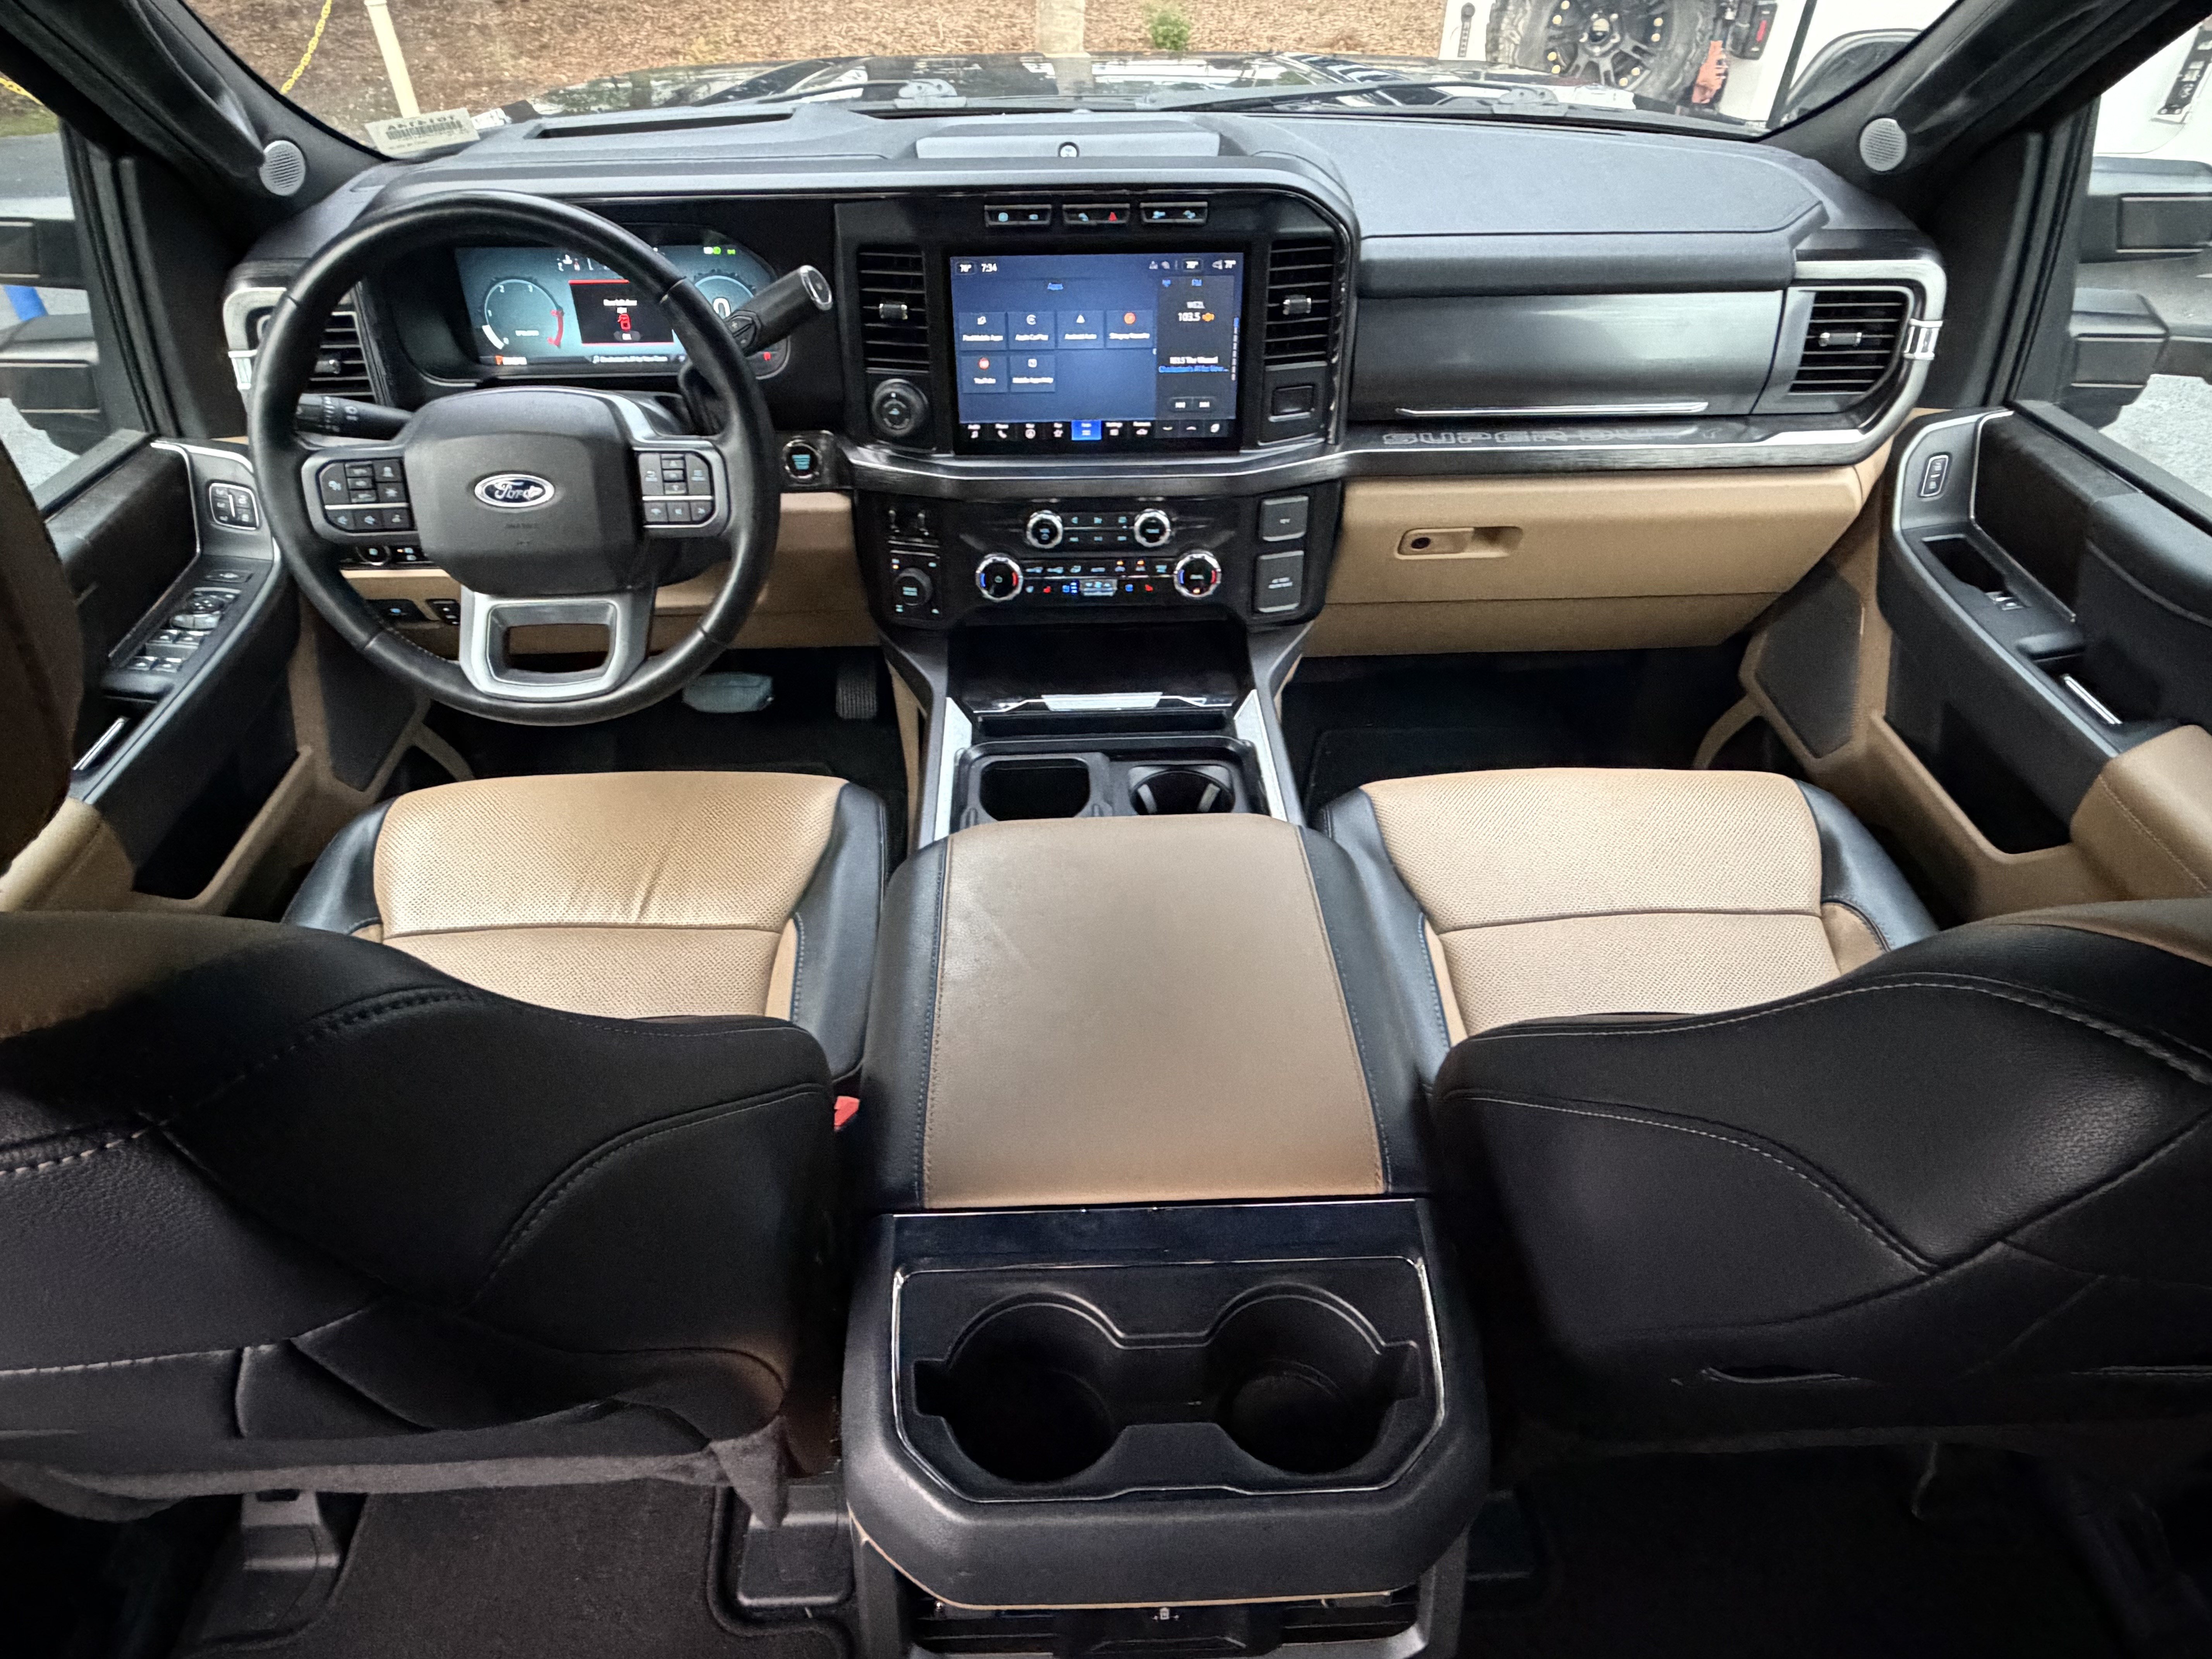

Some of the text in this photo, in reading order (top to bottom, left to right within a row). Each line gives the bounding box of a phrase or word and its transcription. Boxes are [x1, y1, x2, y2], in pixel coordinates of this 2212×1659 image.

[981, 263, 998, 272] 7:34
[1382, 430, 1568, 445] SUPER
[494, 481, 543, 501] Ford
